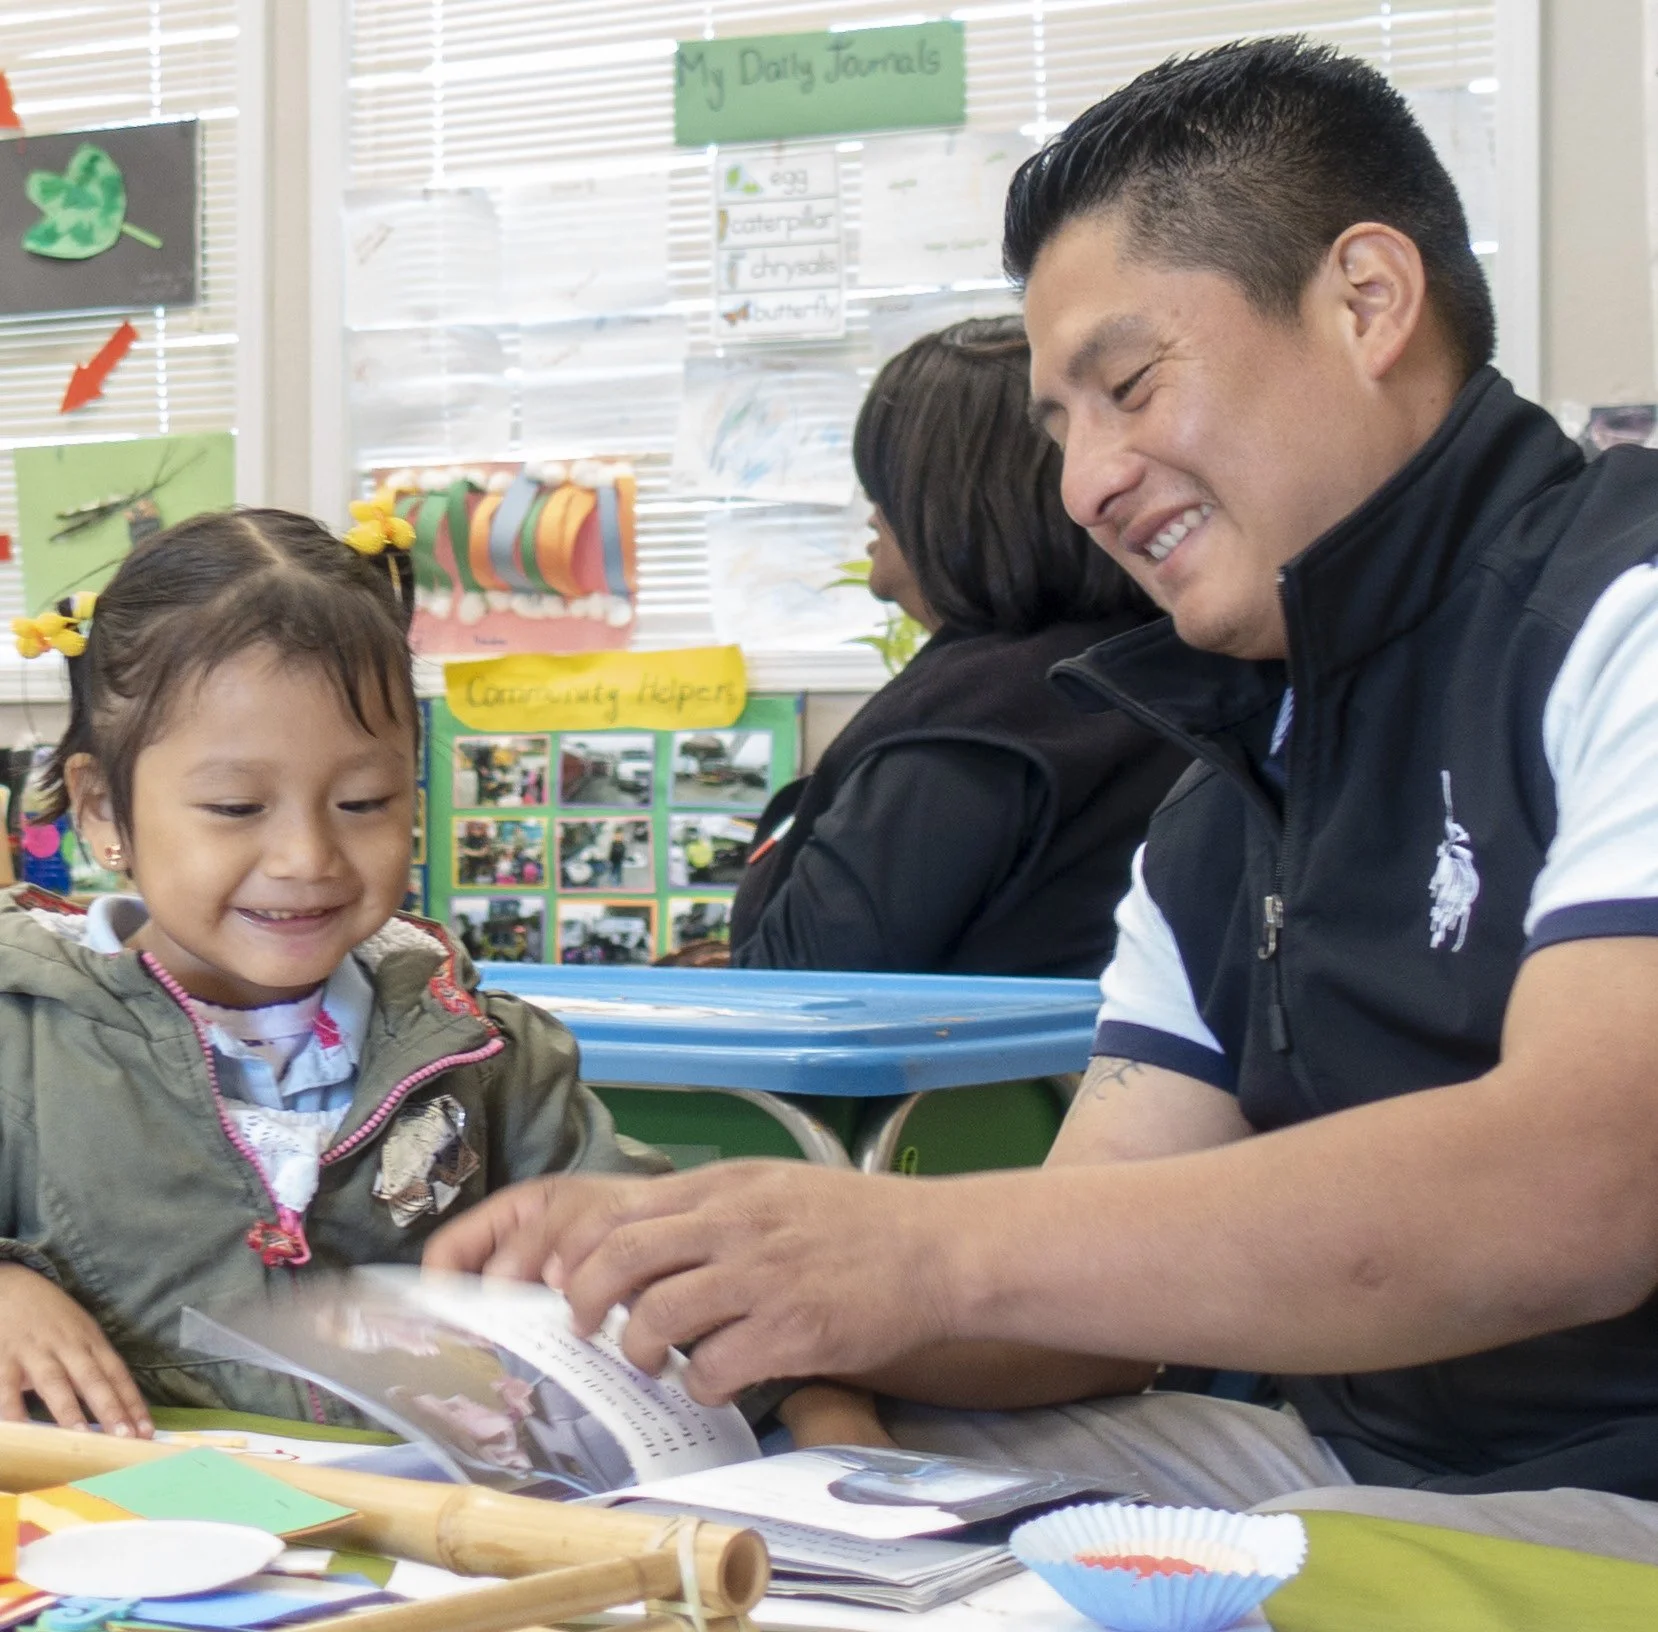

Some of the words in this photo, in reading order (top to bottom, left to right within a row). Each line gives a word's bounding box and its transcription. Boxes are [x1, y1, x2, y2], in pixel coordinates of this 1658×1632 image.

[676, 49, 725, 112] My
[738, 49, 815, 94] Daily
[824, 34, 942, 84] Journals
[769, 168, 809, 196] egg
[731, 203, 834, 241] caterpillar
[750, 248, 838, 285] chrysalis
[754, 293, 839, 322] butterfly
[636, 673, 737, 713] Helpers
[700, 1422, 717, 1442] to
